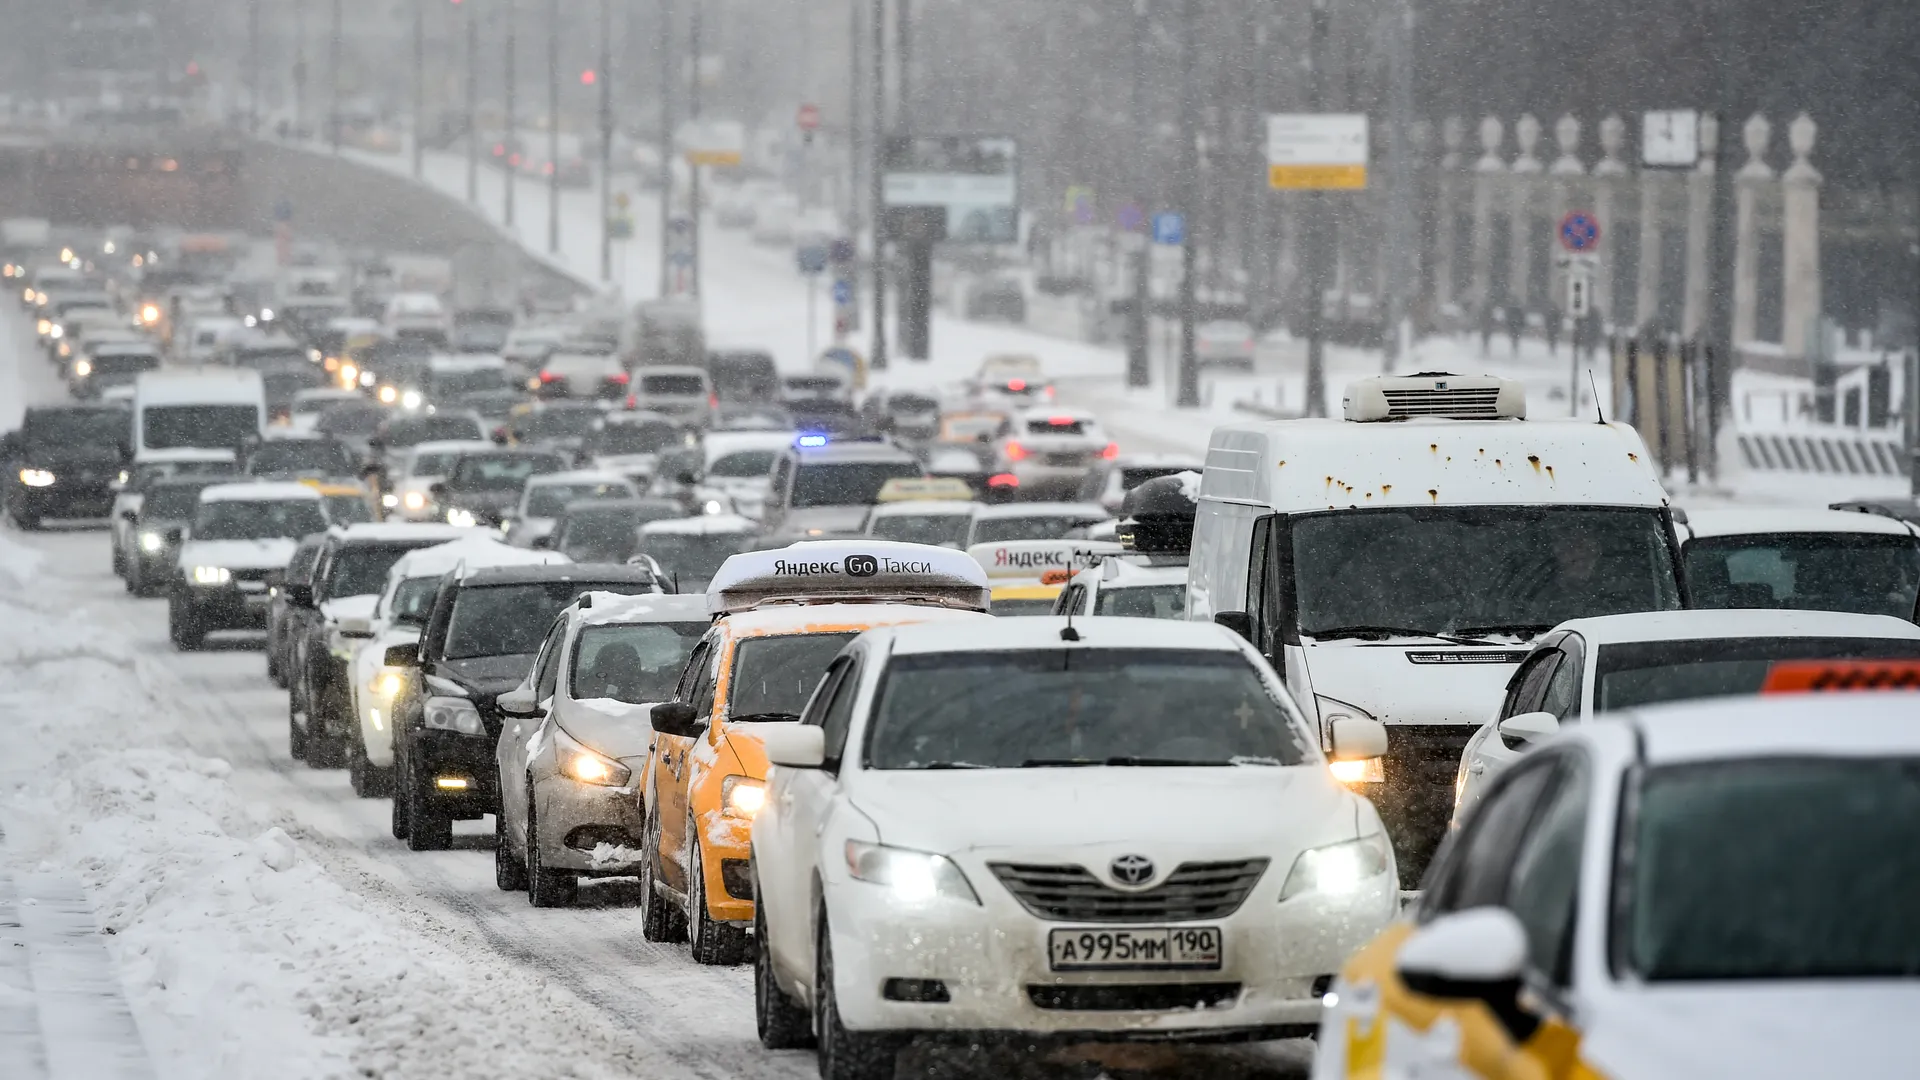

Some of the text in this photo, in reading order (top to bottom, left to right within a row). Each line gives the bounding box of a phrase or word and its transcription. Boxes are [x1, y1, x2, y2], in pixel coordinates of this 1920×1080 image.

[774, 557, 932, 576] Яндекс Go Такси
[994, 548, 1064, 567] Яндекс
[1173, 931, 1212, 951] 190
